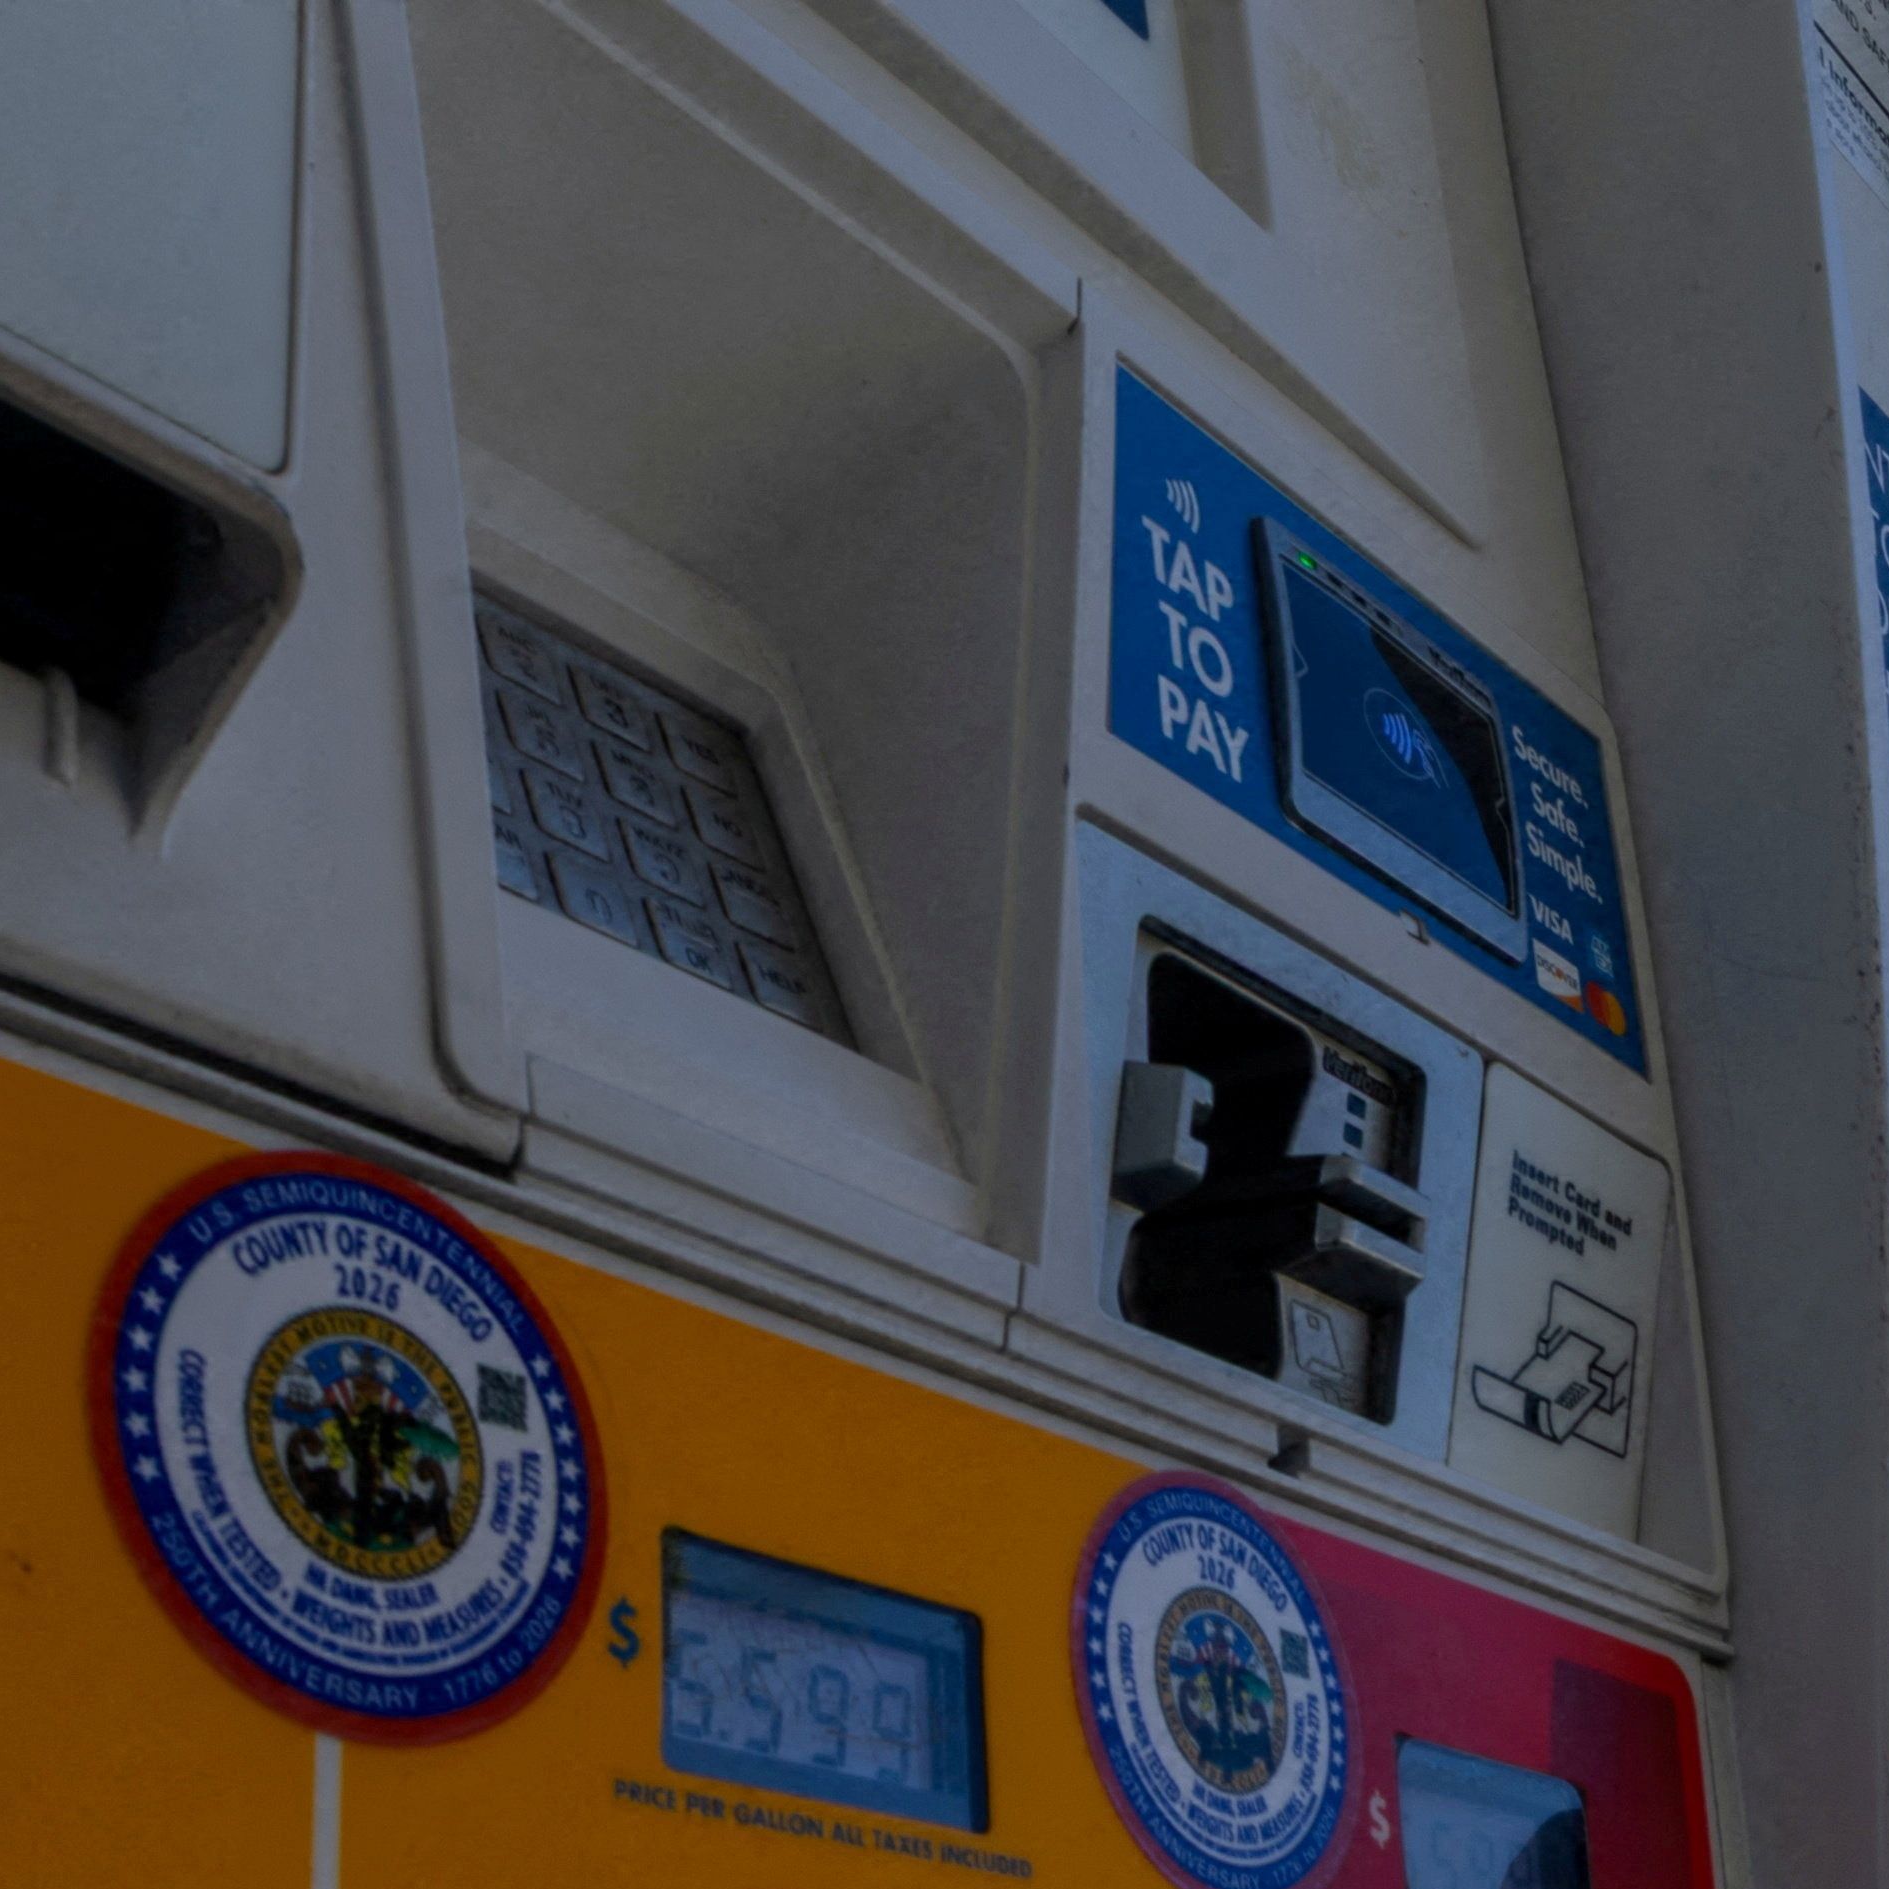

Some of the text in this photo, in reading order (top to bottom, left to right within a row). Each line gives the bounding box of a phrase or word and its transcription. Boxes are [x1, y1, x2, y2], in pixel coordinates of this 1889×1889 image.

[1141, 514, 1235, 622] TAP
[1158, 599, 1234, 699] TO
[1158, 673, 1249, 784] PAY
[1512, 724, 1589, 810] Secure.
[1530, 781, 1585, 848] Safe.
[1525, 820, 1603, 904] Simple.
[1529, 893, 1574, 945] VISA
[1509, 1195, 1585, 1257] Prompted
[1511, 1172, 1571, 1225] Remove
[1513, 1149, 1633, 1236] Insert Card and
[232, 1219, 493, 1342] COUNTY OF SAN DIEGO
[335, 1264, 401, 1312] 2026
[1142, 1523, 1287, 1612] COUNTY OF SAN DIEGO
[1197, 1555, 1235, 1590] 2026
[608, 1595, 640, 1669] $
[614, 1777, 1033, 1880] PRICE PER GALLON ALL TAXES INCLUDED
